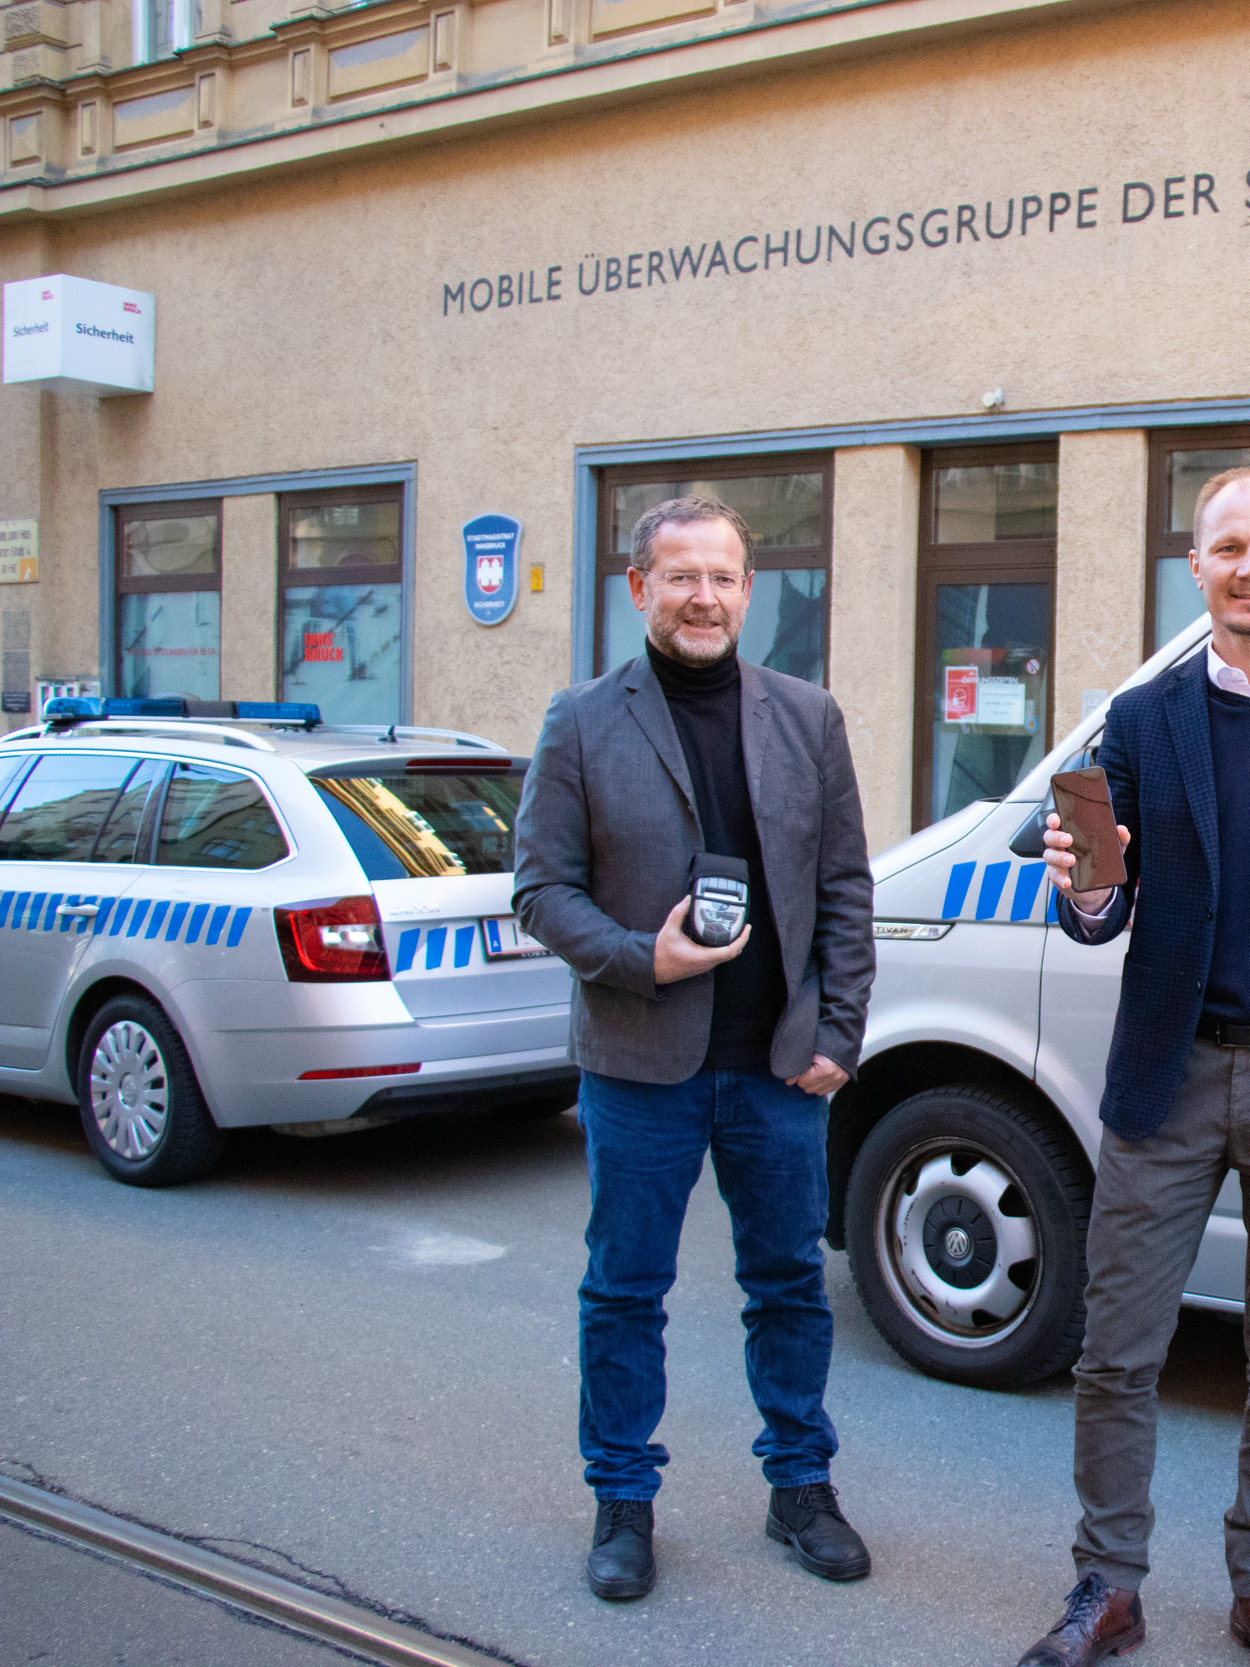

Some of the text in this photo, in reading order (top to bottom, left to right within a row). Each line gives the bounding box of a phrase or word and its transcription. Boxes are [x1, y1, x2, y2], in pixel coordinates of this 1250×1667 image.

[443, 266, 562, 316] MOBILE
[577, 187, 1098, 296] ÜBERWACHUNGSGRUPPE
[1122, 173, 1220, 224] DER
[13, 321, 49, 337] Sicherheit
[76, 322, 135, 344] Sicherheit
[304, 647, 343, 661] BRUCK
[875, 926, 908, 934] TIVAN
[492, 940, 499, 948] A
